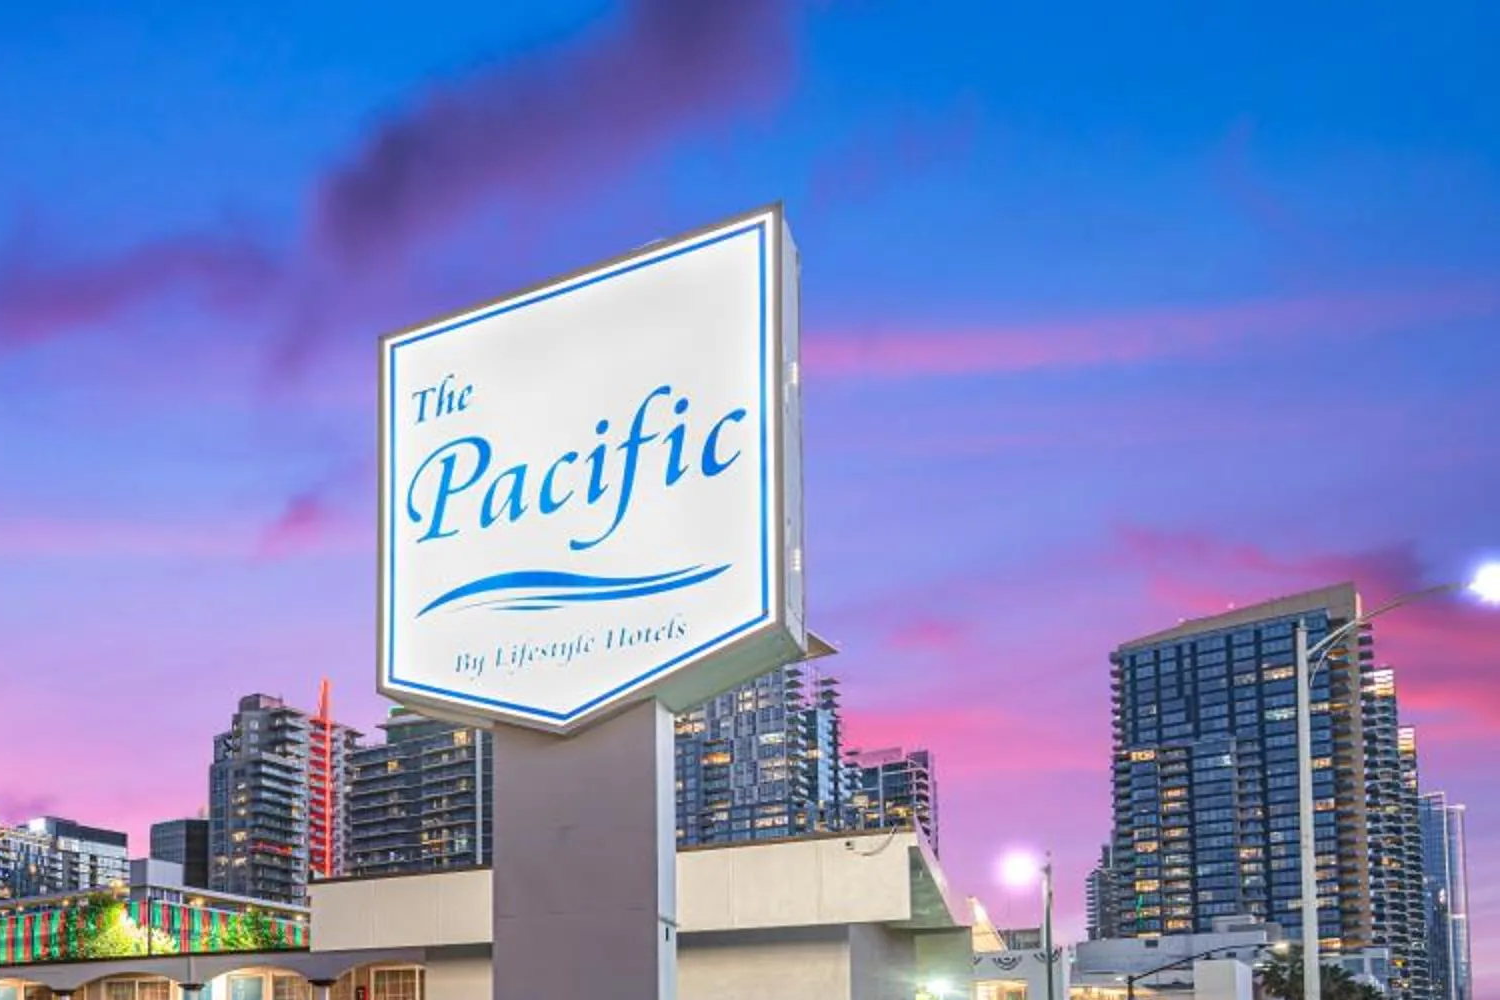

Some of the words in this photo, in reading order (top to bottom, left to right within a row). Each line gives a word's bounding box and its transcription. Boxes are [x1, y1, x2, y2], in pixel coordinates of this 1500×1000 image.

[411, 373, 474, 424] The
[406, 384, 748, 551] Pacific
[454, 652, 486, 678] By
[494, 634, 596, 671] Lifestyle
[604, 615, 688, 650] Hotels
